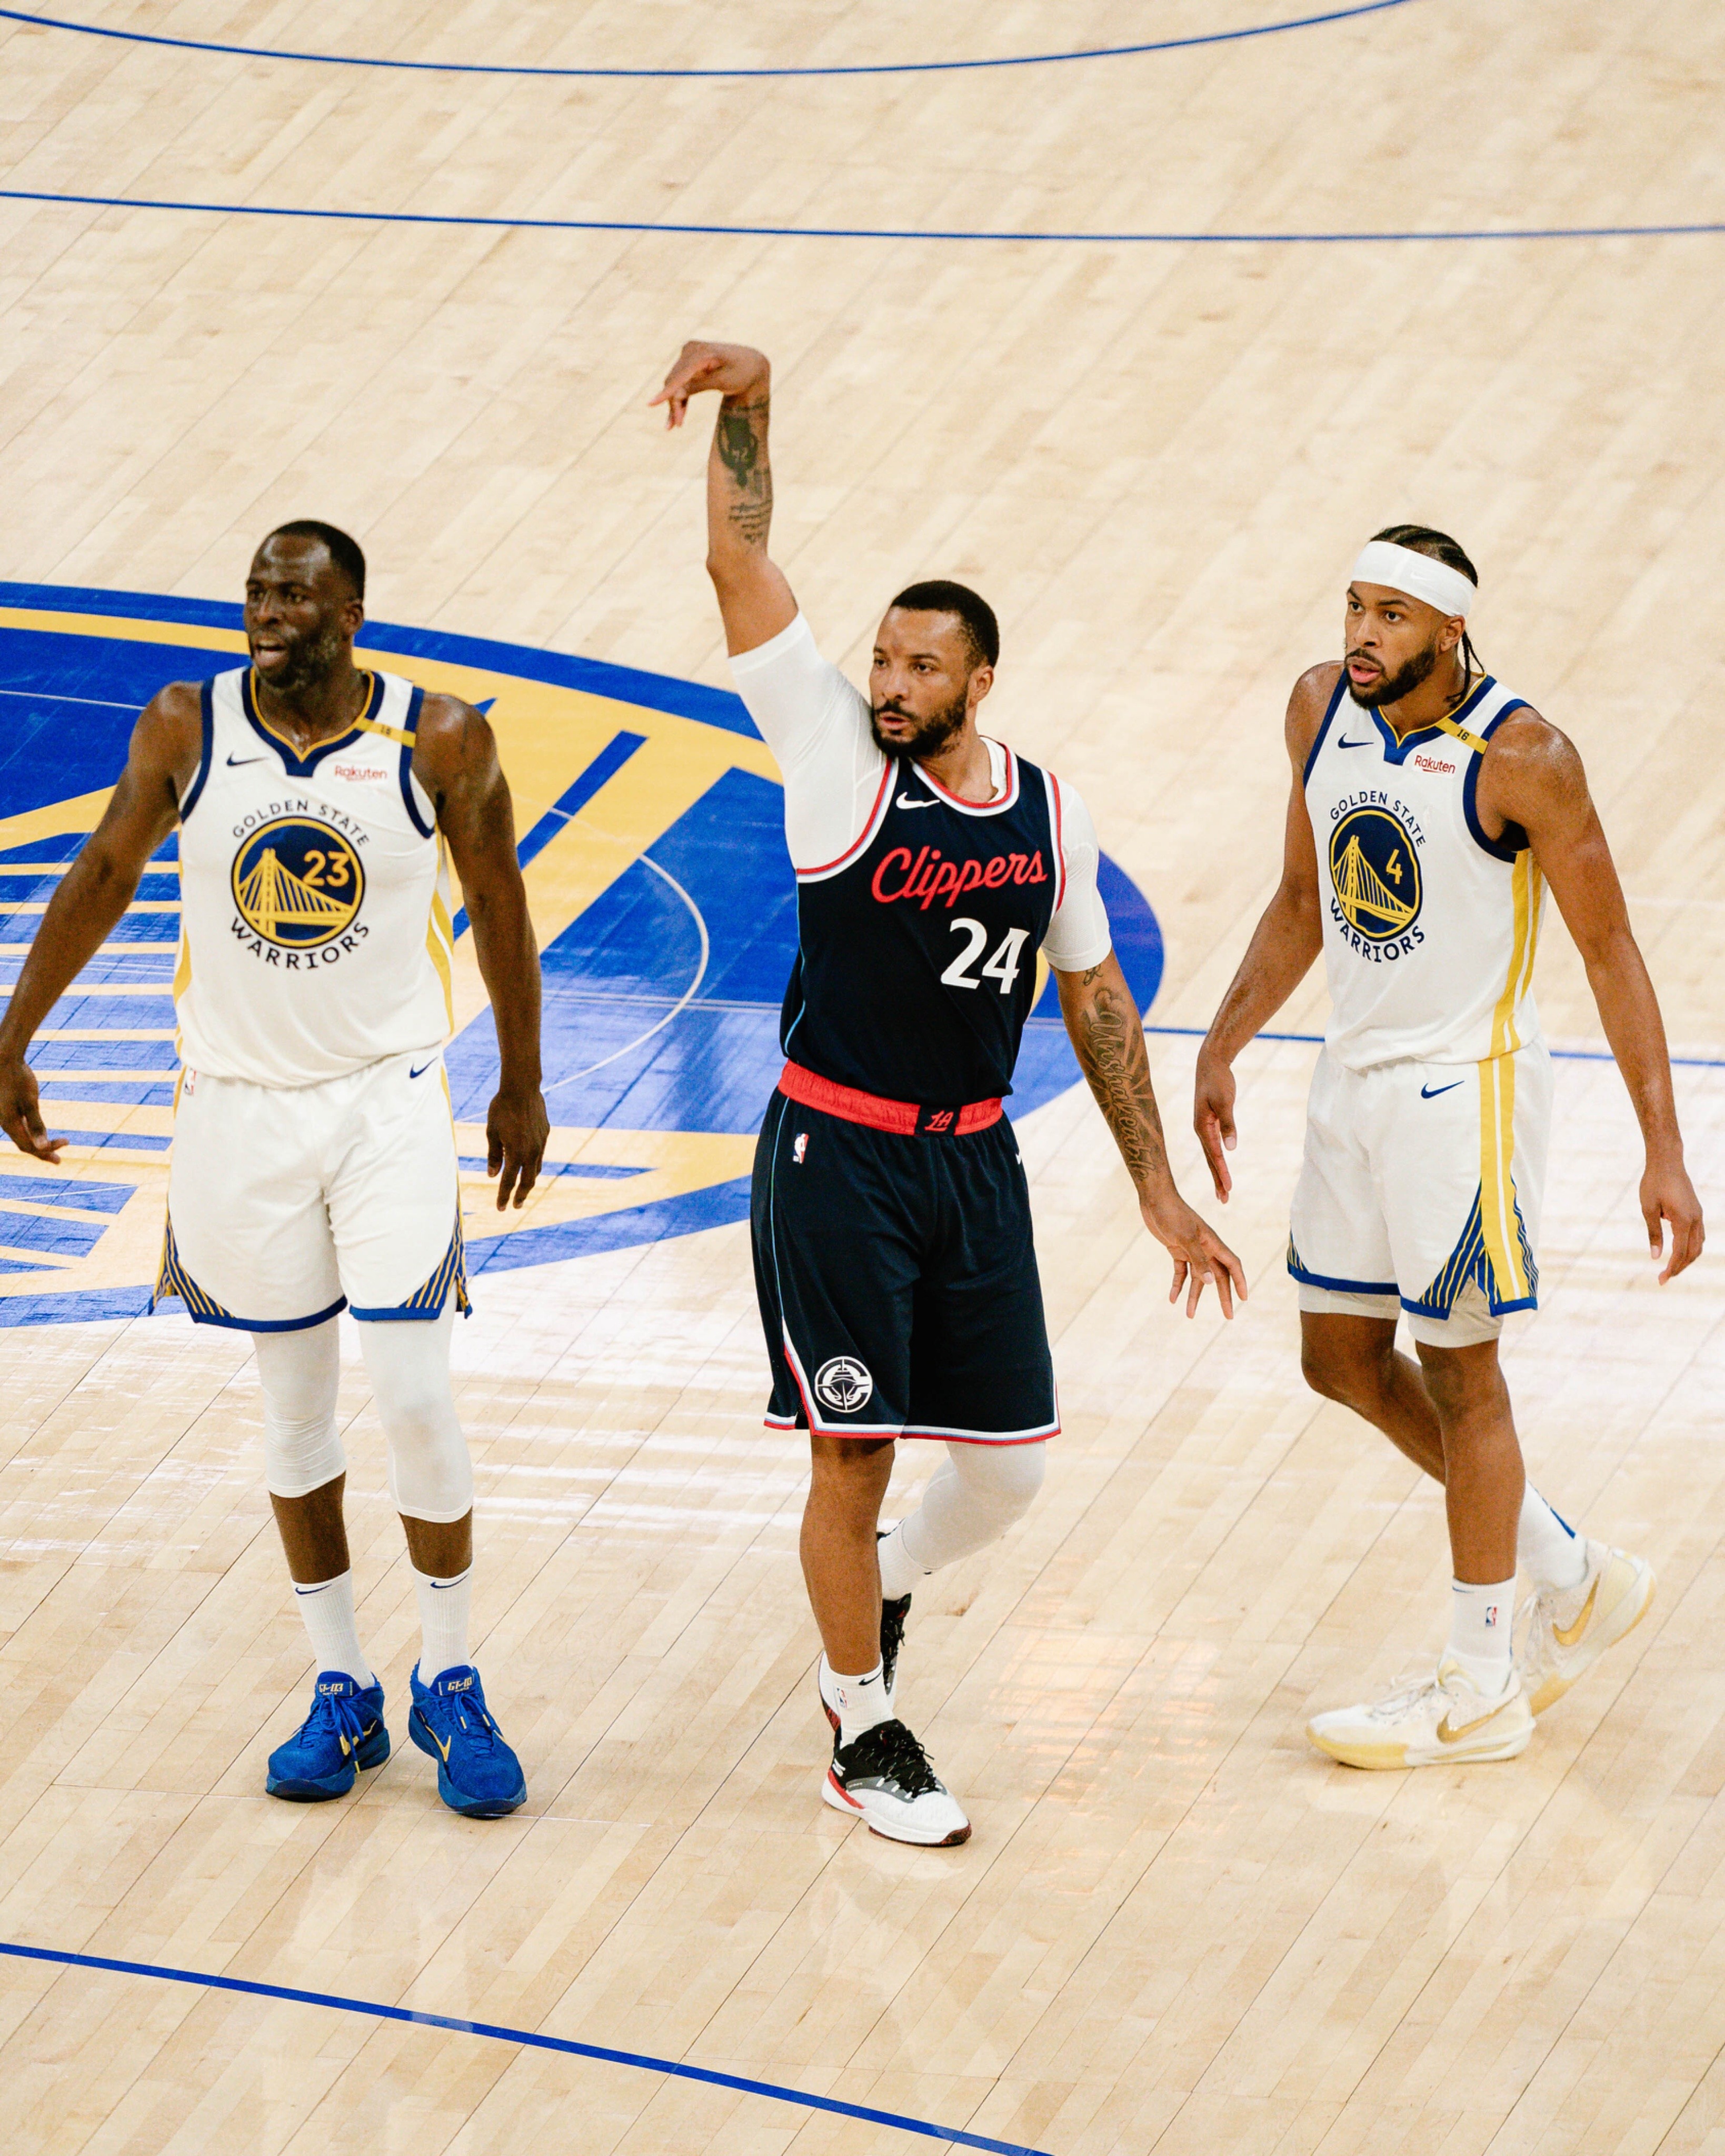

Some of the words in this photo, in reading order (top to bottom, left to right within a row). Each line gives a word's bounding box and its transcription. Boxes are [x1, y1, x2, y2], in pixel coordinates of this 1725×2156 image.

[1457, 729, 1470, 741] 16
[334, 764, 388, 780] Rakuten
[1414, 754, 1456, 774] Rakuten
[233, 800, 308, 839] GOLDEN
[319, 805, 369, 846] STATE
[1330, 790, 1388, 821] GOLDEN
[1392, 800, 1427, 847] STATE
[303, 849, 350, 887] 23
[871, 845, 1049, 911] Clippers
[1385, 849, 1403, 885] 4
[231, 916, 370, 970] WARRIORS
[1330, 895, 1425, 963] WARRIORS
[940, 917, 1031, 994] 24
[924, 1110, 954, 1132] LA
